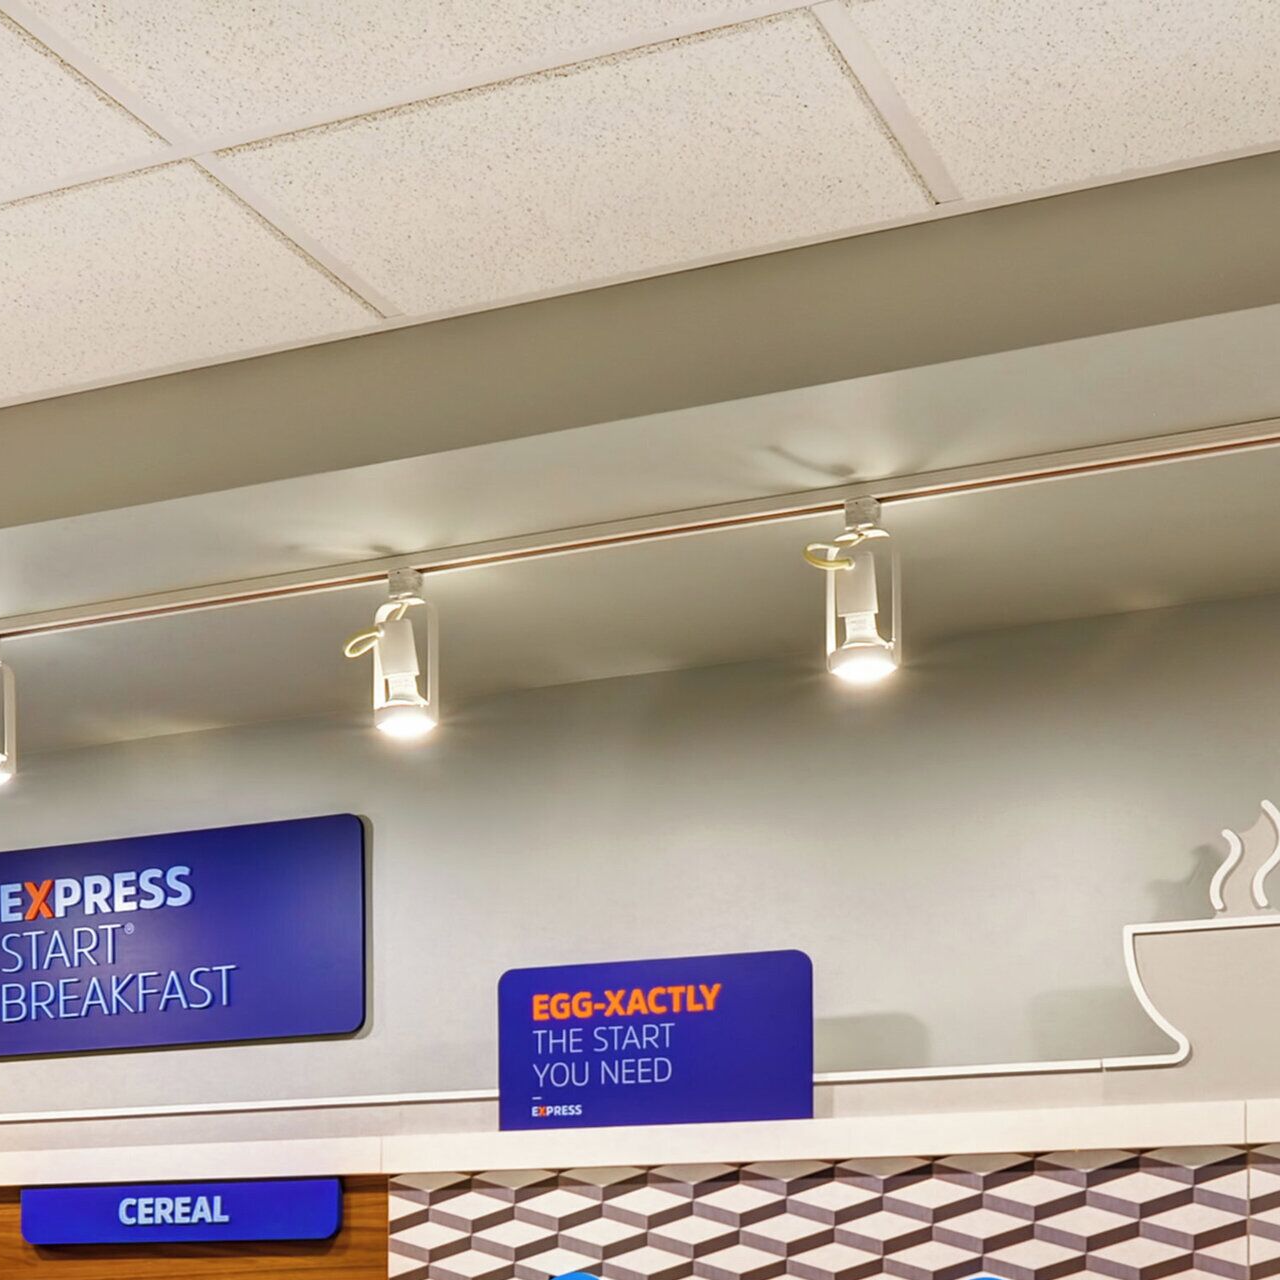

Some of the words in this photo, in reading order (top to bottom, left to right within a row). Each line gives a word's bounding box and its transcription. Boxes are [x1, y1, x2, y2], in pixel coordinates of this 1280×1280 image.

[0, 865, 193, 923] EXPRESS
[1, 965, 237, 1024] BREAKFAST
[532, 983, 721, 1021] EGG-XACTLY
[532, 1028, 583, 1054] THE
[593, 1023, 675, 1052] START
[532, 1060, 589, 1088] YOU
[601, 1057, 672, 1085] NEED
[531, 1104, 582, 1117] EXPRESS
[118, 1195, 230, 1226] CEREAL
